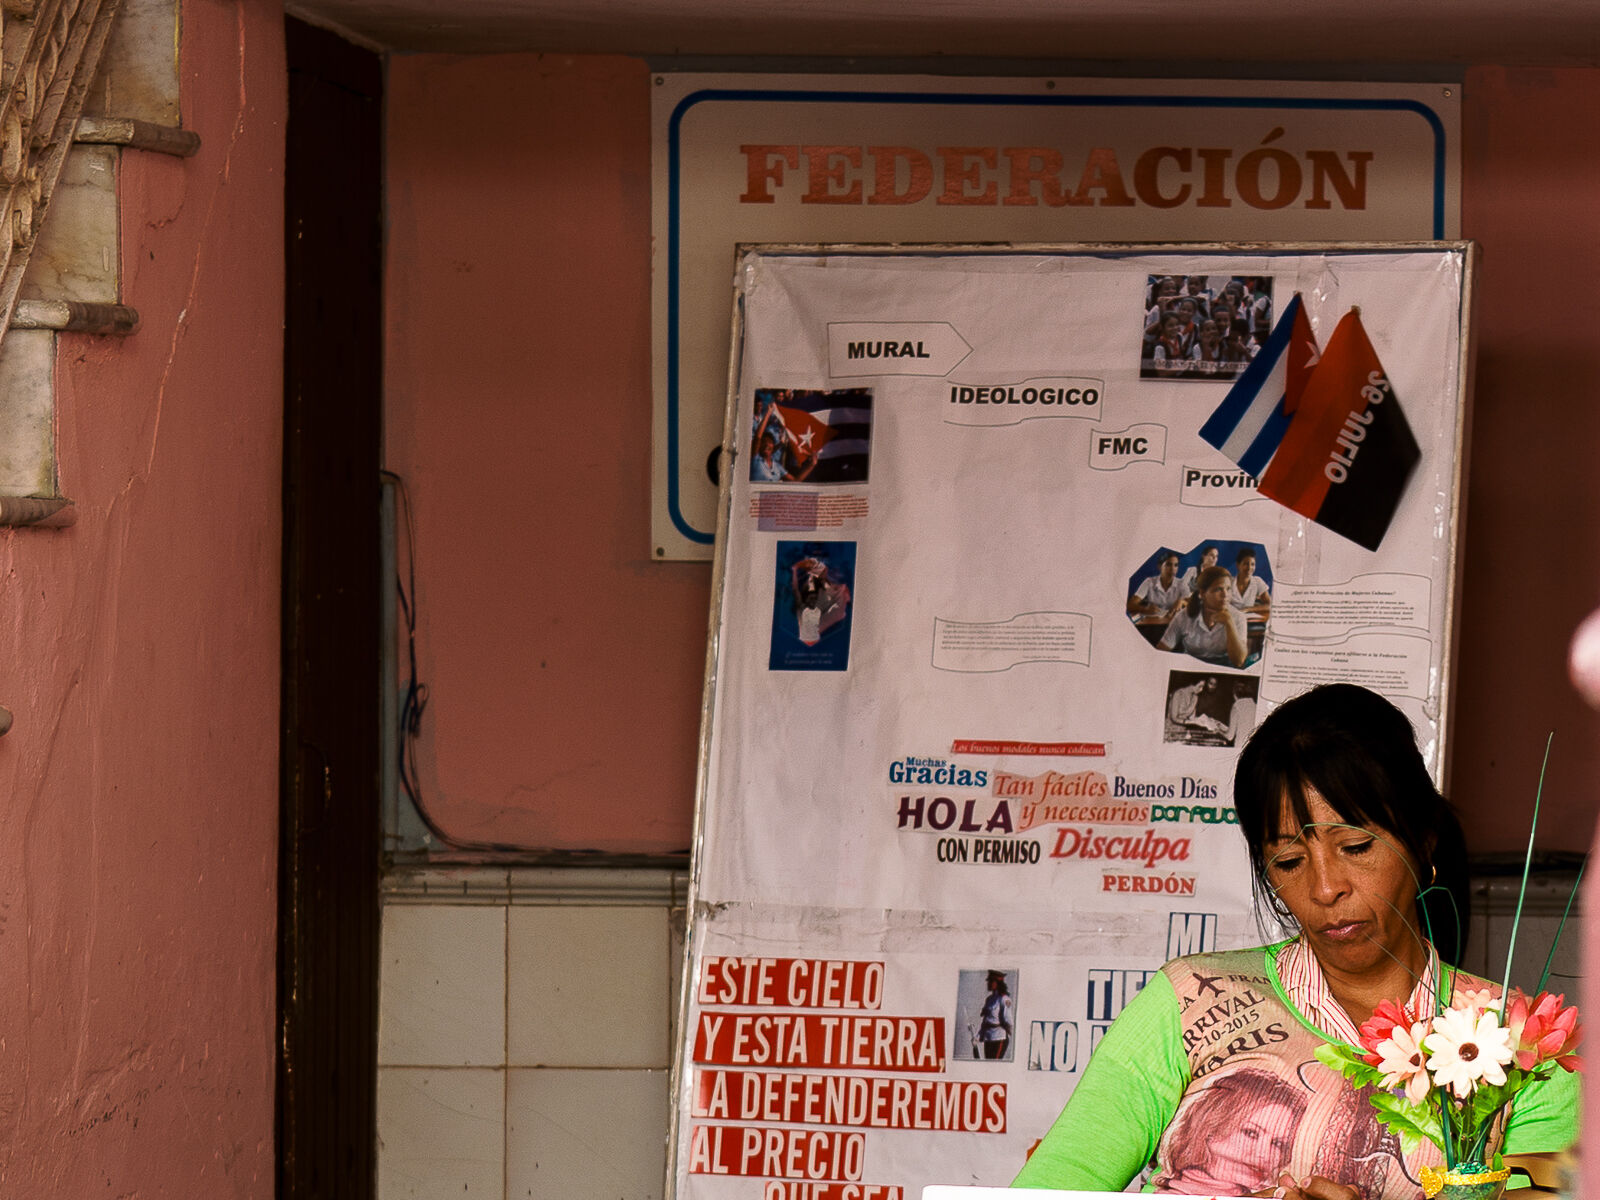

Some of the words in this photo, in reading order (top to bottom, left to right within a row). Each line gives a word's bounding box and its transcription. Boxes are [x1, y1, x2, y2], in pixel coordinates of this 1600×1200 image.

[739, 126, 1373, 211] FEDERACIÓN
[847, 341, 930, 359] MURAL
[950, 387, 1099, 406] IDEOLOGICO
[1097, 437, 1148, 455] FMC
[1185, 470, 1259, 488] Provin
[889, 761, 988, 787] Gracias
[905, 757, 947, 767] Muchas
[994, 775, 1034, 796] Tan
[1033, 772, 1109, 805] fáciles
[1113, 775, 1175, 798] Buenos
[1180, 776, 1218, 799] Días
[897, 796, 1014, 834] HOLA
[1019, 803, 1037, 830] y
[1043, 804, 1149, 822] necesarios
[936, 837, 968, 862] CON
[972, 838, 1041, 865] PERMISO
[1049, 827, 1193, 869] Disculpa
[1102, 872, 1196, 895] PERDÓN
[699, 956, 778, 1005] ESTE
[787, 959, 884, 1010] CIELO
[1182, 989, 1266, 1057] RRIVAL
[702, 1015, 725, 1062] Y
[731, 1015, 808, 1064] ESTA
[820, 1016, 946, 1073] TIERRA,
[1028, 1021, 1078, 1072] NO
[691, 1070, 730, 1119] LA
[740, 1071, 1007, 1133] DEFENDEREMOS
[690, 1125, 729, 1174] AL
[740, 1127, 865, 1182] PRECIO
